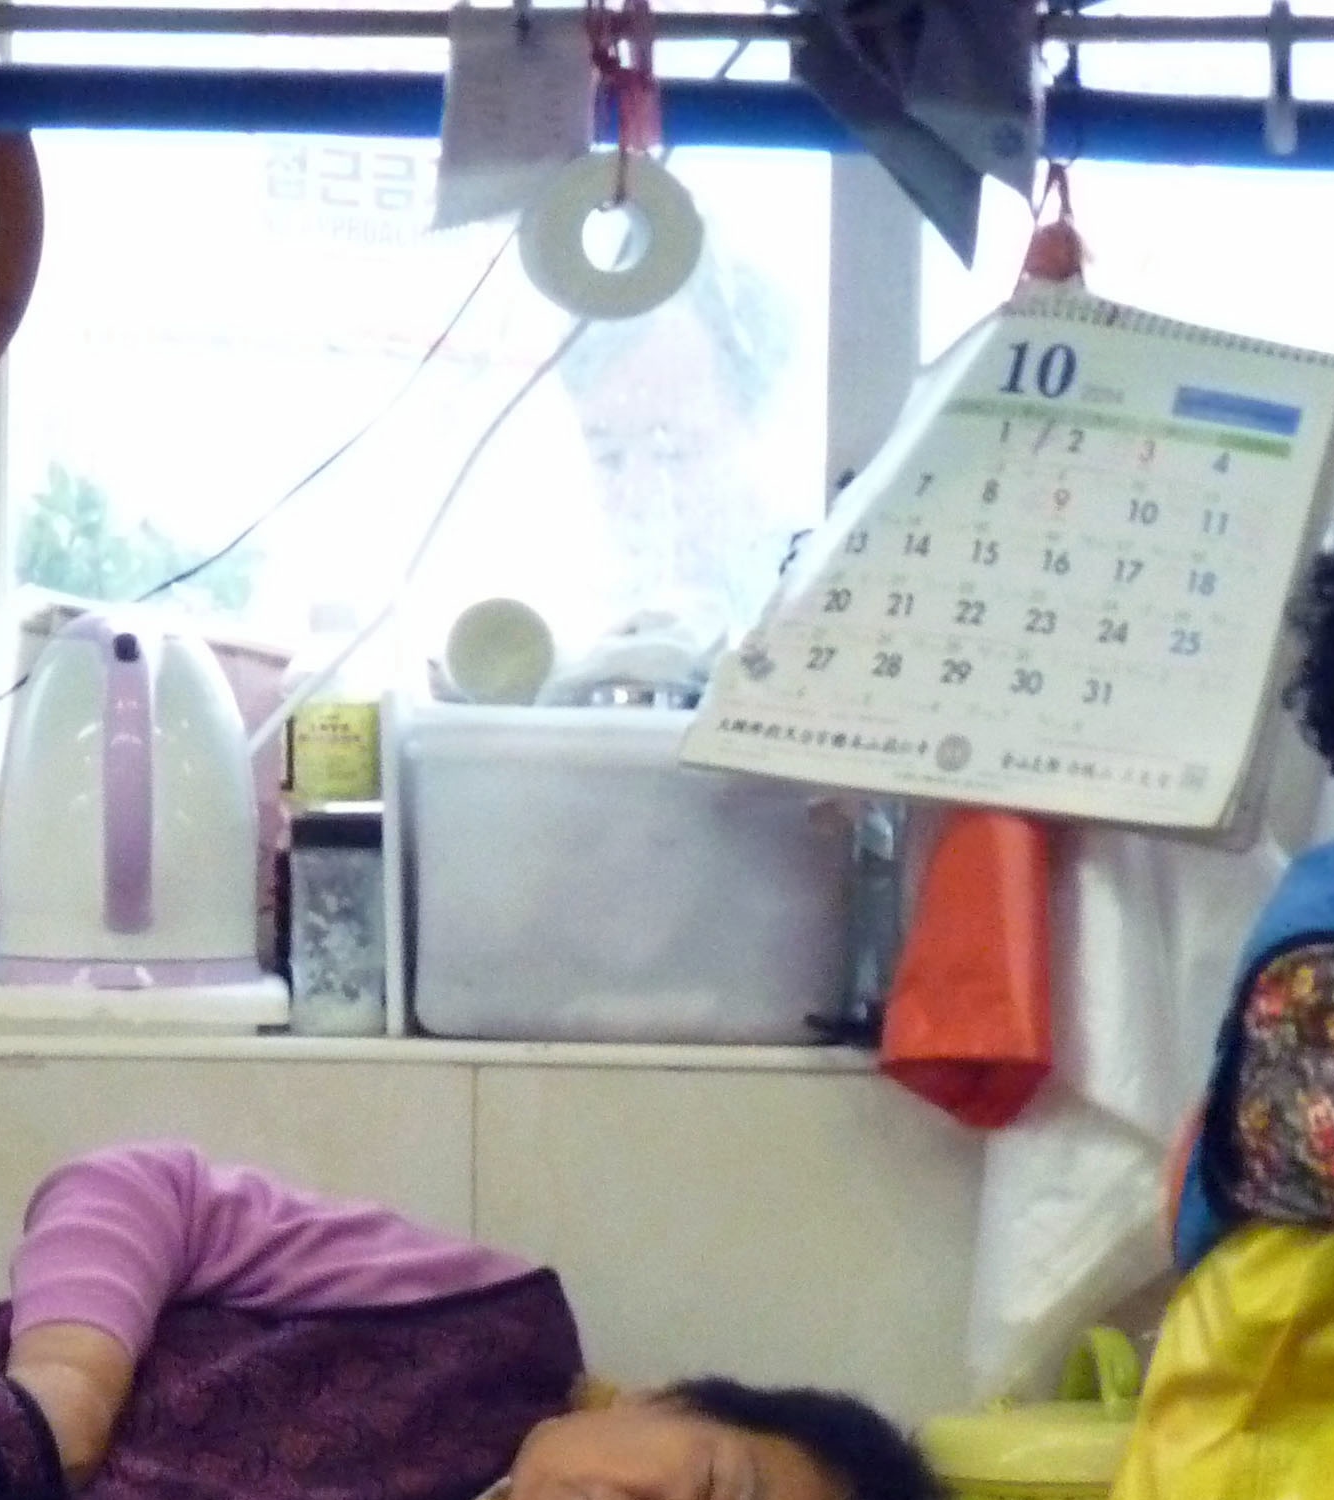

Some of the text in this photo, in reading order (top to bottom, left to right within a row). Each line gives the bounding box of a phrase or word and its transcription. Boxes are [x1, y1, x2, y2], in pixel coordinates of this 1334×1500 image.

[263, 143, 438, 210] 접근금
[999, 341, 1077, 398] 10
[1000, 421, 1230, 473] 1 2 3 4
[916, 472, 1229, 535] 7 8 9 10 11
[903, 532, 931, 557] 14
[971, 539, 999, 566] 15
[1042, 549, 1070, 576] 16
[1114, 559, 1144, 584] 17
[1187, 569, 1216, 596] 18
[824, 588, 1201, 656] 20 21 22 23 24 25
[807, 647, 838, 672] 27
[872, 651, 903, 678] 28
[940, 658, 972, 684] 29
[1010, 668, 1043, 695] 30
[1082, 678, 1113, 704] 31
